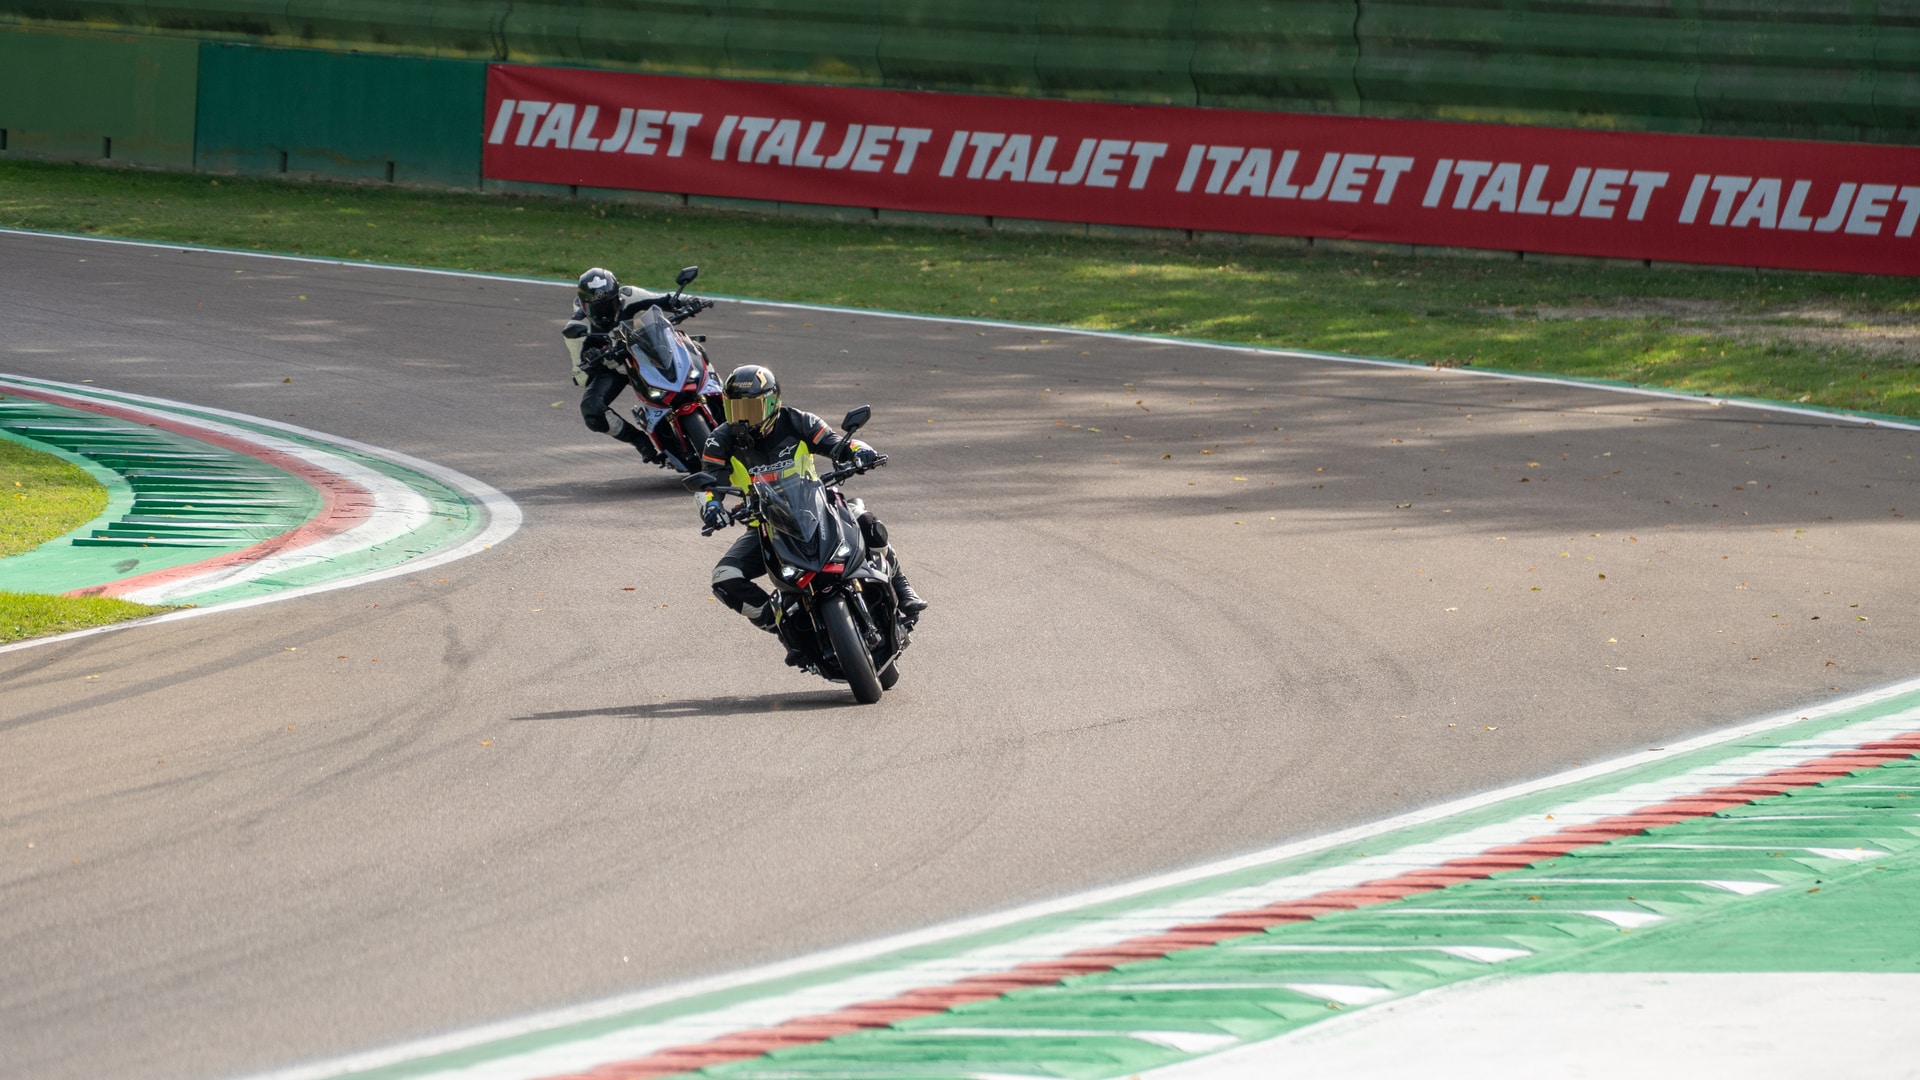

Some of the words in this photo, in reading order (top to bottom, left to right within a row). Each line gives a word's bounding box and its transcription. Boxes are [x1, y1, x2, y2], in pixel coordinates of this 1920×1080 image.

[489, 100, 703, 157] ITALJET
[712, 116, 933, 174] ITALJET
[940, 131, 1169, 189] ITALJET
[1176, 145, 1415, 204] ITALJET
[1422, 159, 1670, 221] ITALJET
[1679, 175, 1920, 237] ITALJET
